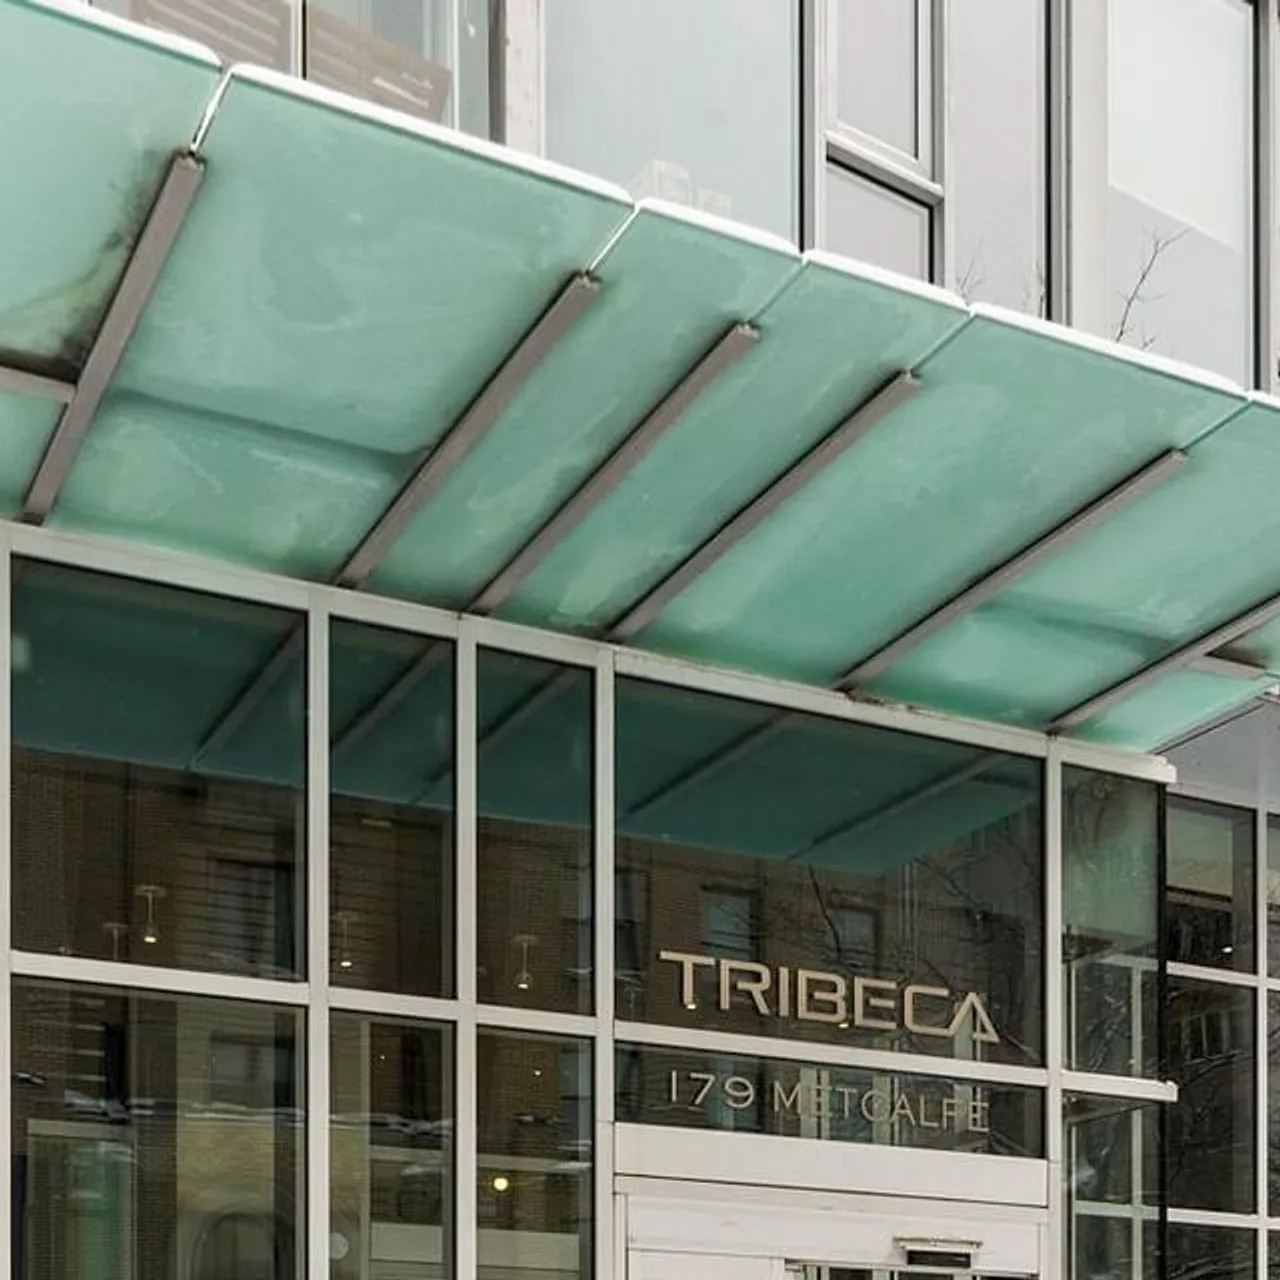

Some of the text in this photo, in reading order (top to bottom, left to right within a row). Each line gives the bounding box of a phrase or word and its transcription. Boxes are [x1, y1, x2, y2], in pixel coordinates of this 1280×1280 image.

[659, 949, 1001, 1044] TRIBECA
[671, 1069, 989, 1133] 179 METCALFE
